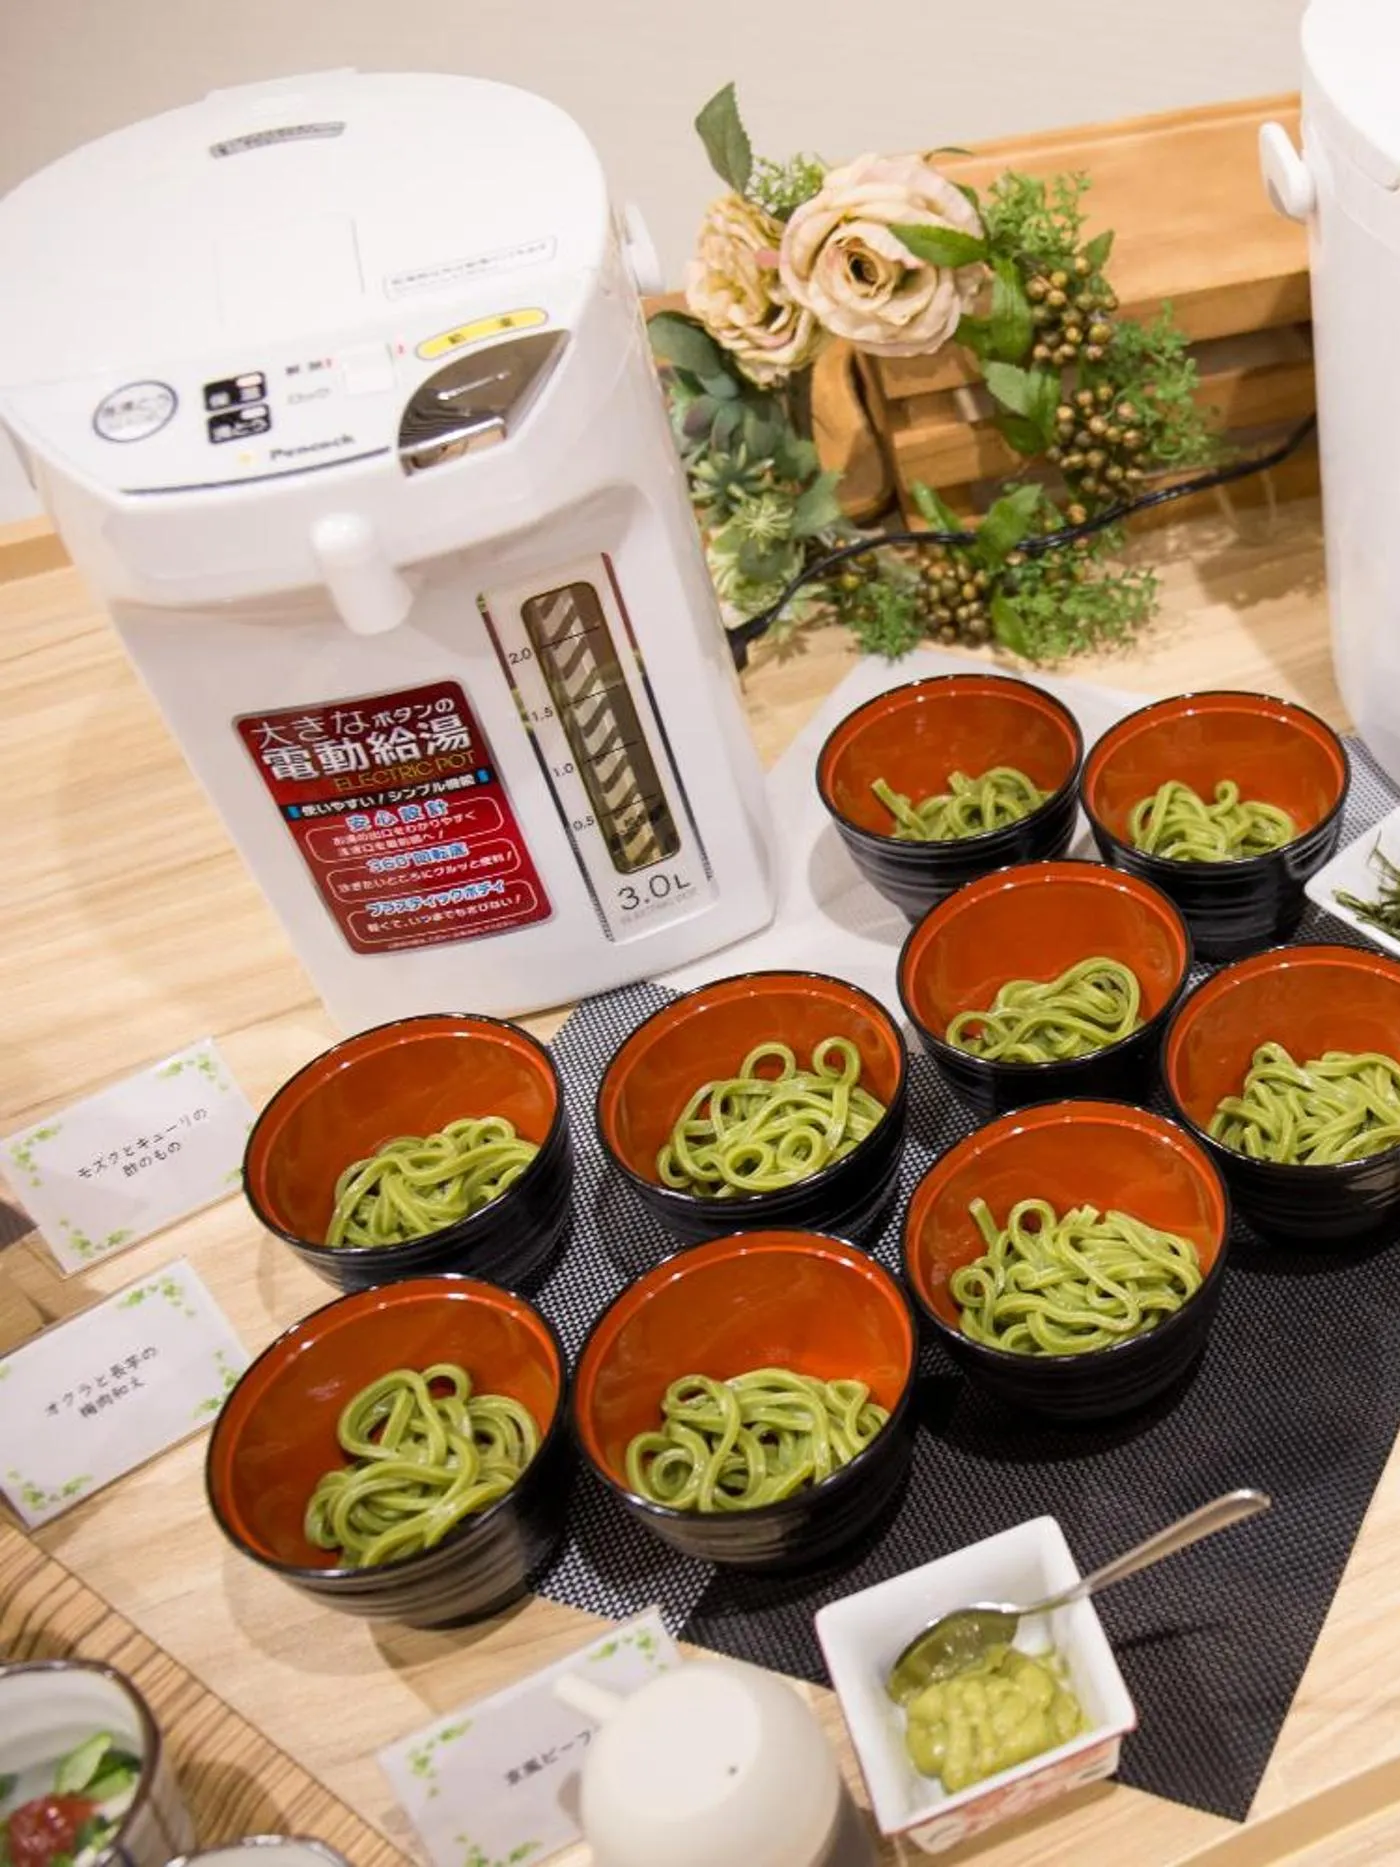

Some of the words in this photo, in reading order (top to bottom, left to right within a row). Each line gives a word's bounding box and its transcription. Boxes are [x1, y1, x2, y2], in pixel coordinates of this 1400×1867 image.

[509, 647, 531, 665] 2.0
[251, 697, 454, 749] 大きなボタンの
[531, 706, 553, 722] 1.5
[262, 714, 472, 782] 電動給湯
[334, 761, 434, 792] ELECTRIC
[437, 750, 475, 770] POT
[553, 762, 574, 777] 1.0
[573, 816, 595, 831] 0.5
